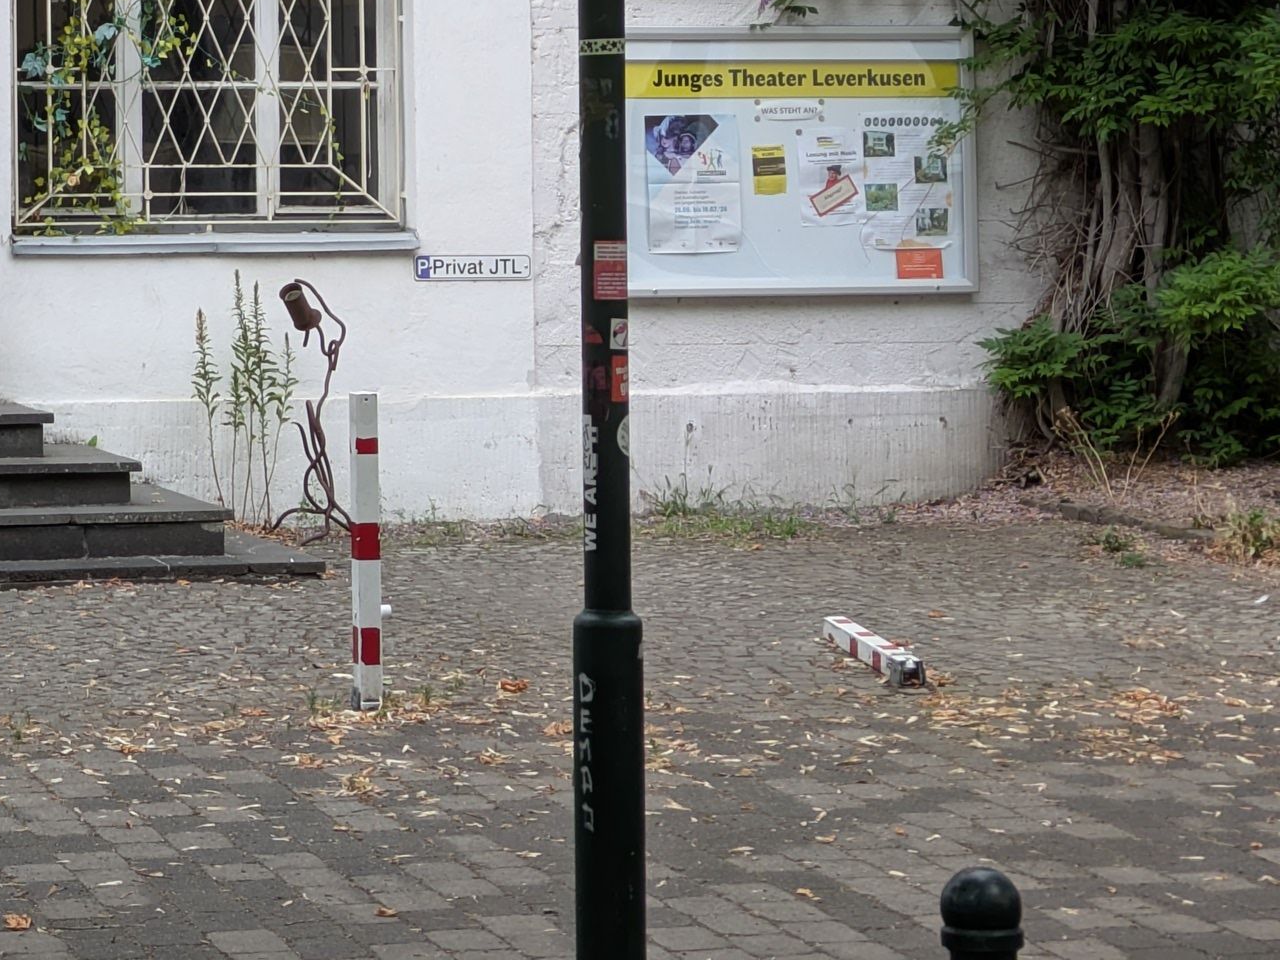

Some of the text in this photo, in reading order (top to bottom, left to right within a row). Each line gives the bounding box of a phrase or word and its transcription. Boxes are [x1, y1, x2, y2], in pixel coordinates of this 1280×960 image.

[652, 68, 926, 93] Junges Theater Leverkusen
[761, 107, 818, 115] WAS STEHT AN?
[433, 258, 483, 275] Privat
[489, 258, 522, 275] JTL
[584, 513, 598, 552] WE
